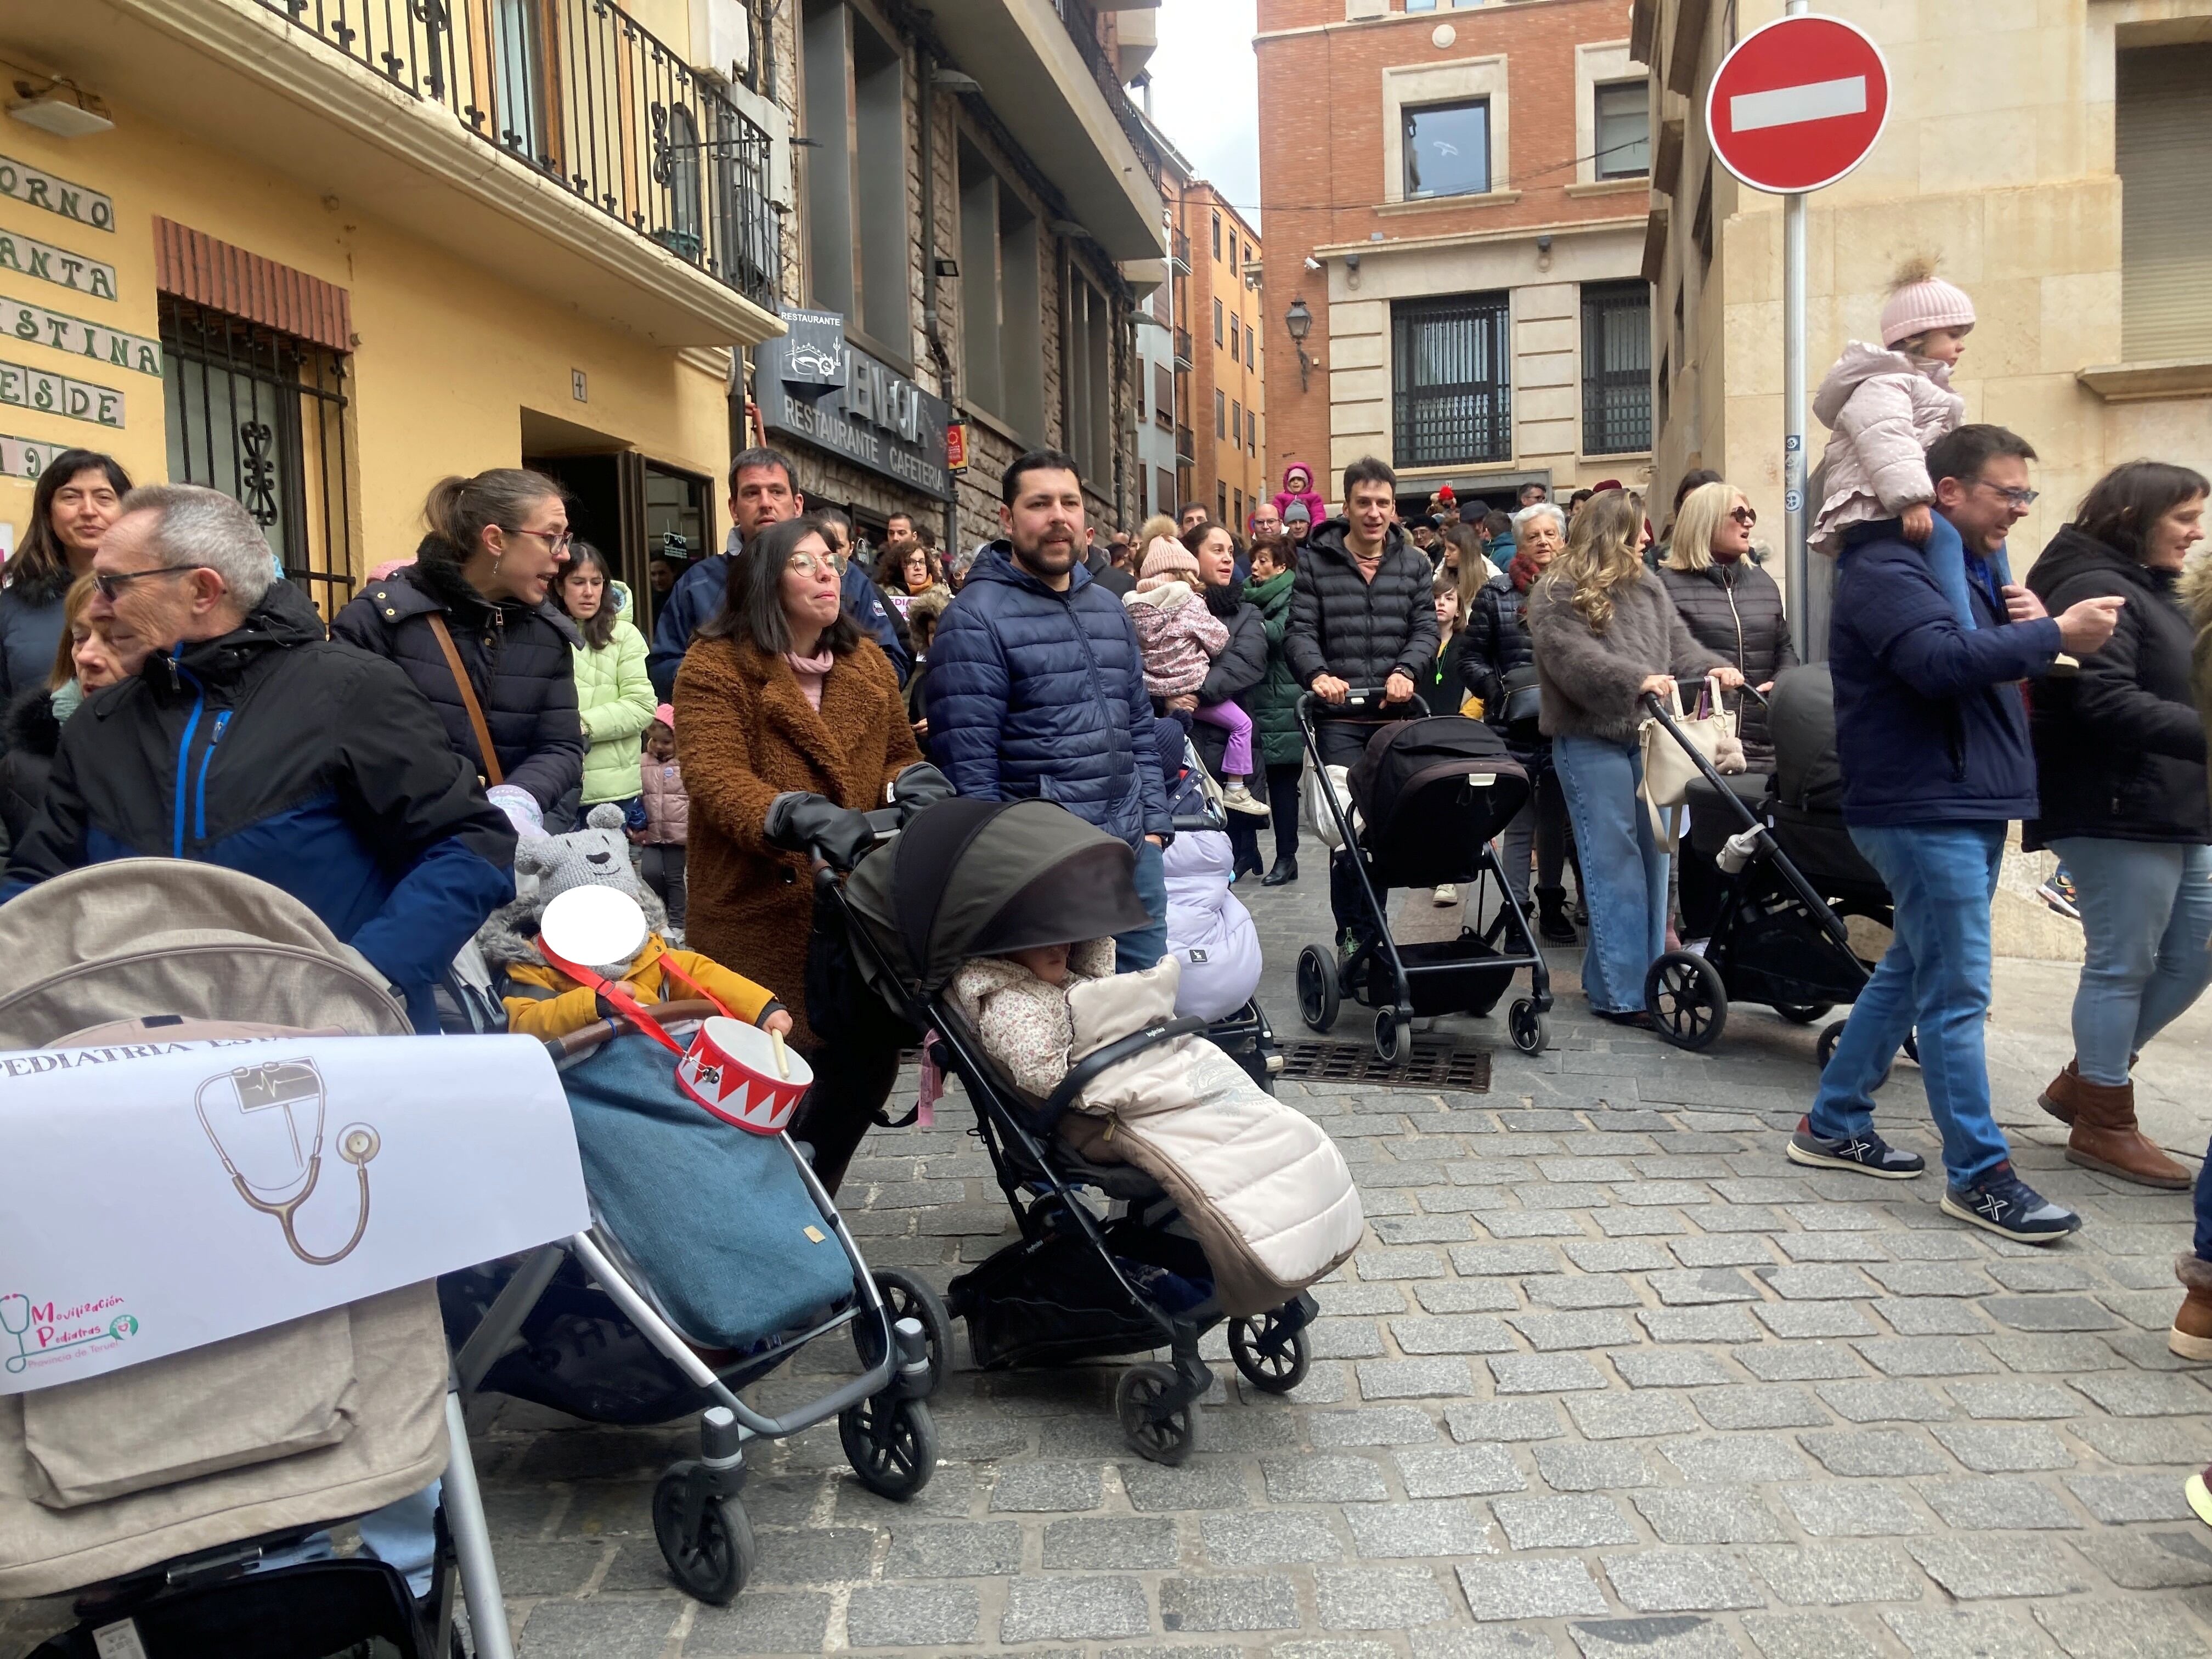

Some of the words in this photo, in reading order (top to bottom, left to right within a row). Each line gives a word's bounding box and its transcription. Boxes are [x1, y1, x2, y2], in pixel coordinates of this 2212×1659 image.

[781, 312, 841, 326] RESTAURANTE
[0, 302, 160, 374] STINA
[784, 394, 879, 464] RESTAURANTE
[889, 446, 945, 493] CAFETERIA
[0, 1042, 193, 1077] EDIATRIA
[36, 1325, 101, 1348] Pediatras
[28, 1354, 72, 1368] Provincia
[75, 1349, 87, 1358] de
[90, 1339, 119, 1353] Teruel
